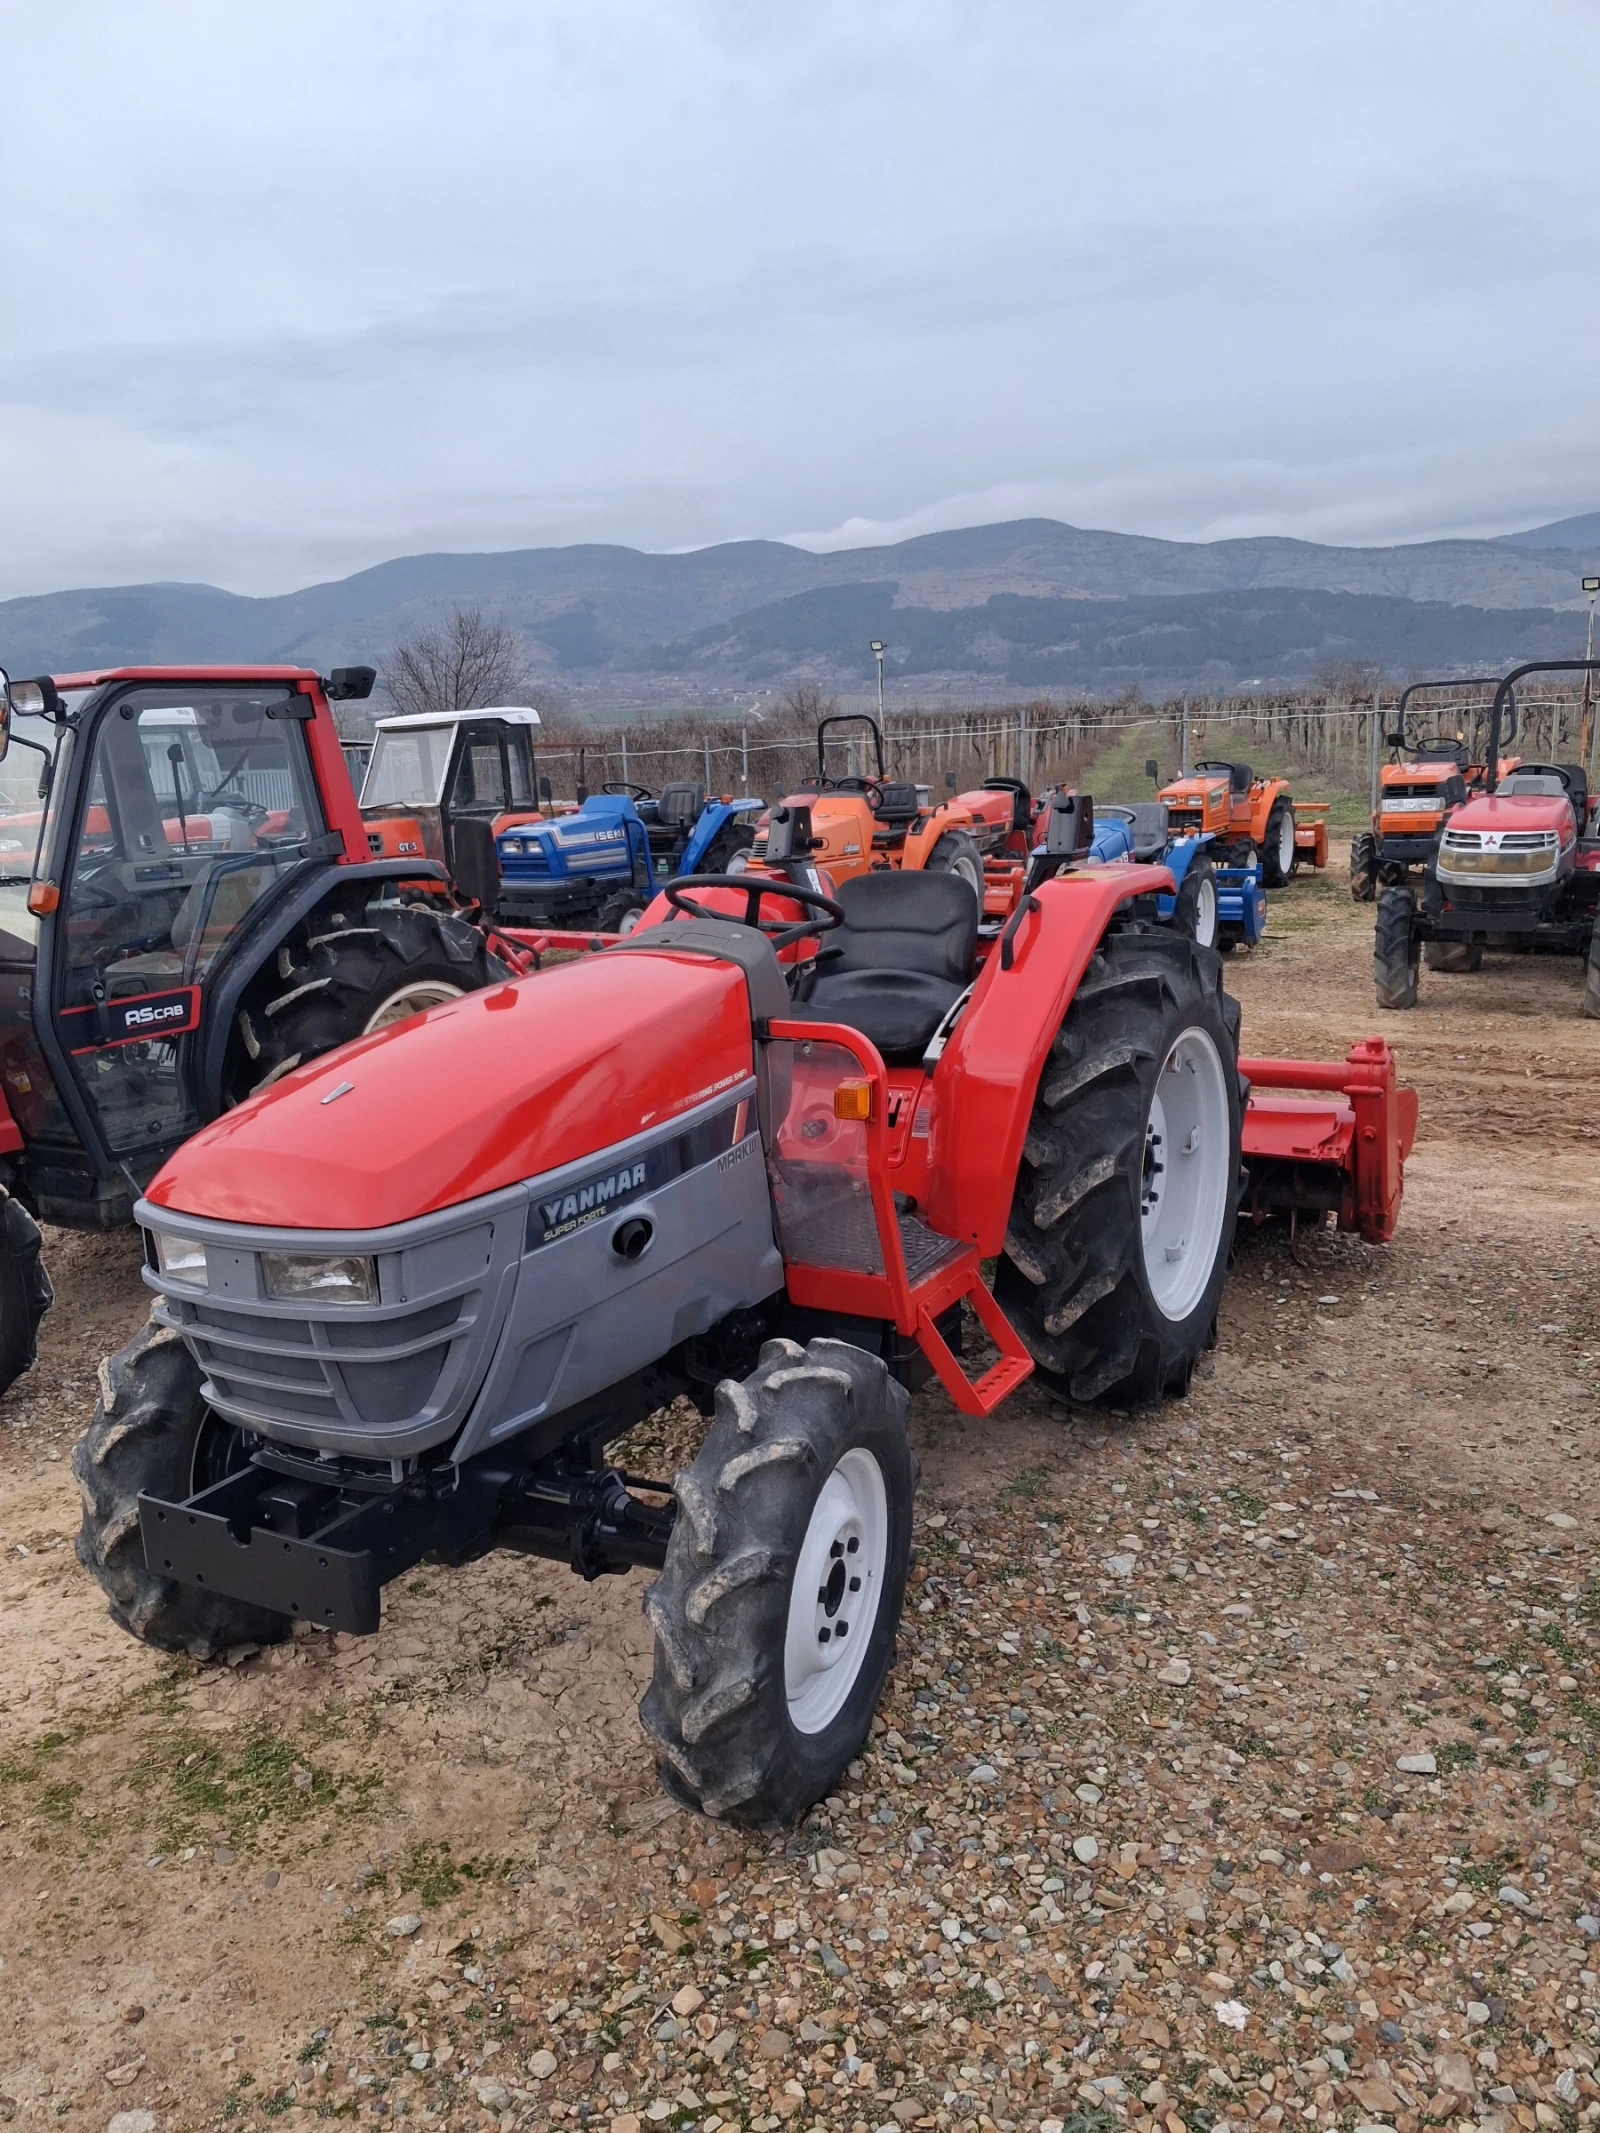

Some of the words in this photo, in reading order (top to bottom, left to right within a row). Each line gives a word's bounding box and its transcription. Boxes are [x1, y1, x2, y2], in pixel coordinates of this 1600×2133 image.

[595, 829, 625, 841] ISEKI
[717, 1142, 749, 1174] MARK
[544, 1162, 646, 1226] YANMAR
[543, 1220, 577, 1242] SUPER
[578, 1206, 607, 1226] FORTE
